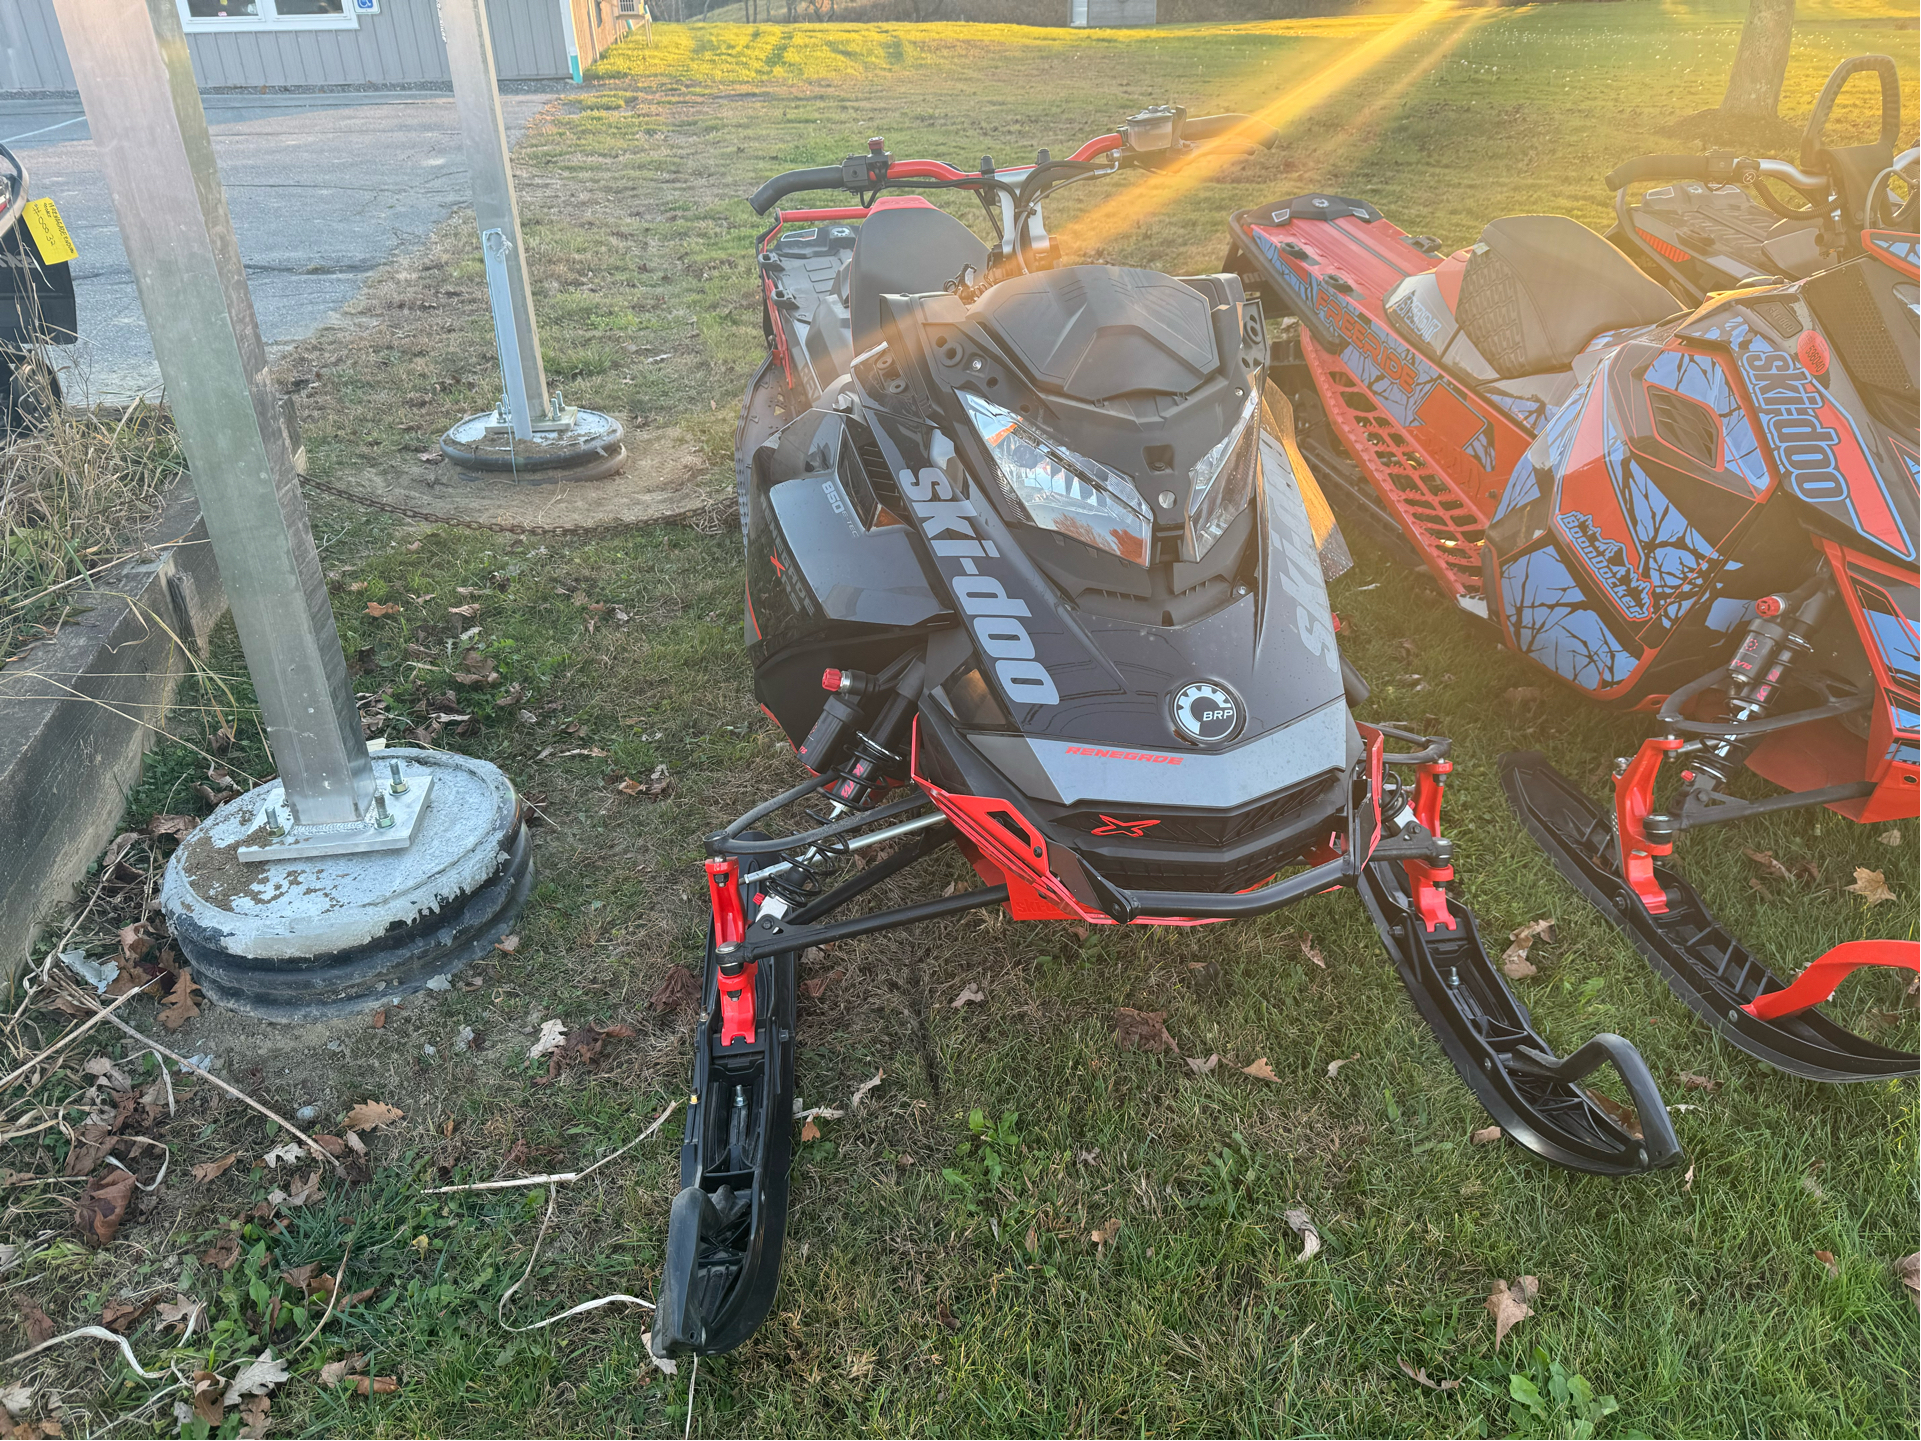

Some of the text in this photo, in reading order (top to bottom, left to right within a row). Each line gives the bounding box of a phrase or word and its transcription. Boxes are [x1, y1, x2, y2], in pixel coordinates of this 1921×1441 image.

[1314, 287, 1419, 396] FREERIDE
[1805, 344, 1826, 373] 536040
[1742, 351, 1849, 502] ski-doo
[821, 480, 845, 514] 850
[760, 492, 815, 616] RENEGADE
[899, 467, 1060, 705] ski-doo
[1562, 516, 1643, 613] BoonDocker
[1065, 746, 1184, 766] RENEGADE
[1203, 709, 1233, 722] BRP
